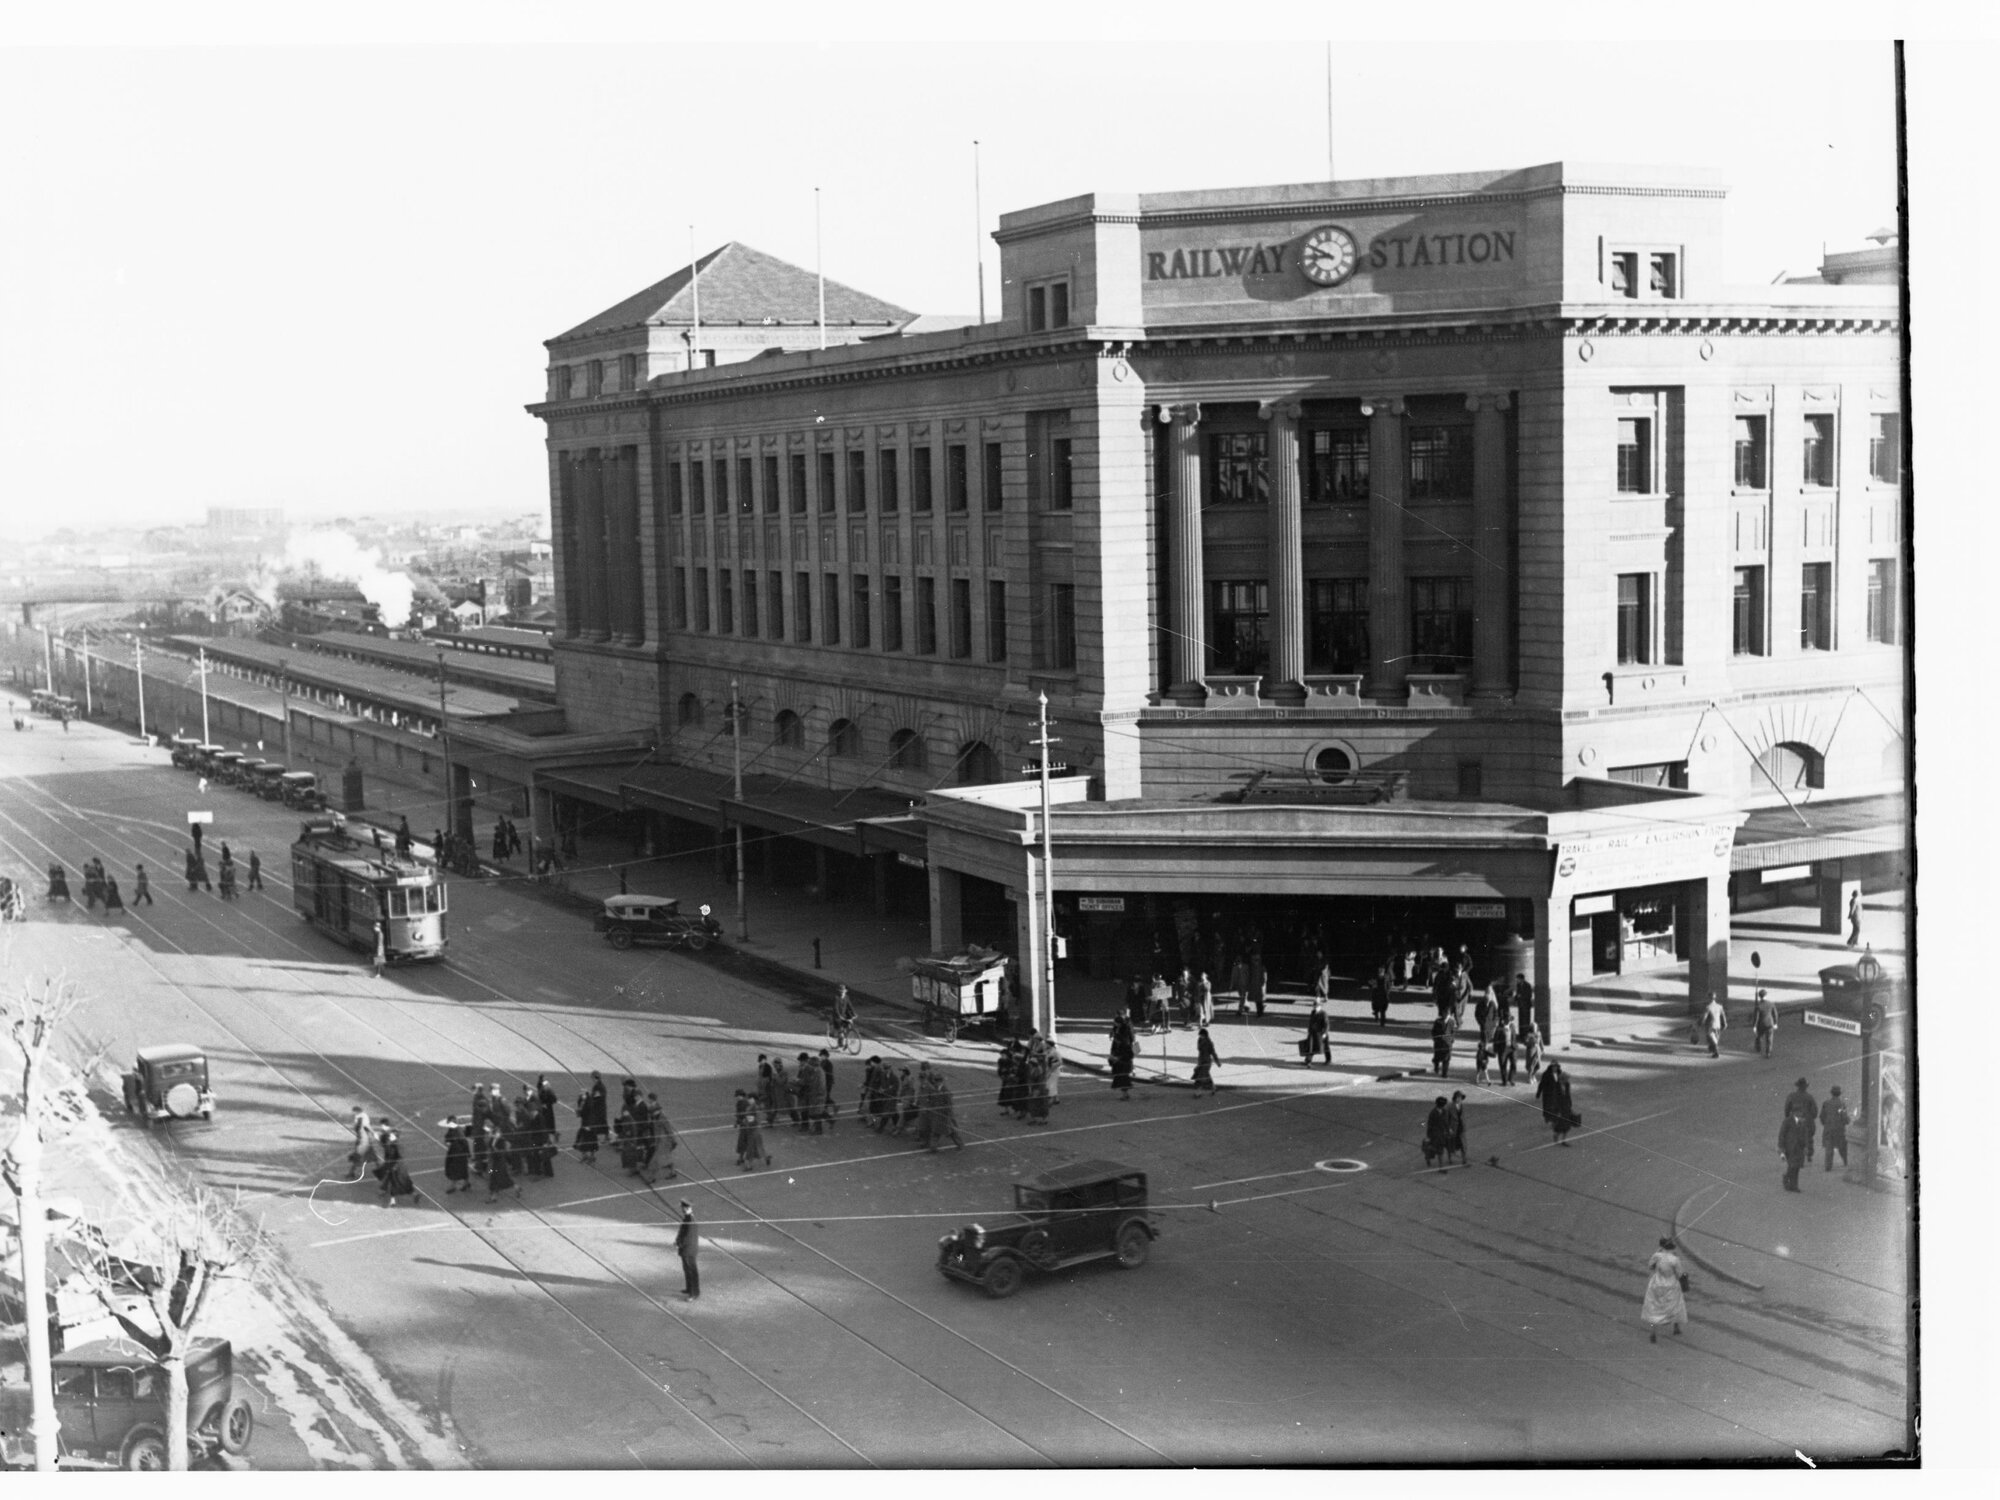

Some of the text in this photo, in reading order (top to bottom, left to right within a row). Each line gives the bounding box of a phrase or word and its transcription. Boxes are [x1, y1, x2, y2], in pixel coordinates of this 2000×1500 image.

[1147, 231, 1516, 281] RAILWAY STATION
[1562, 843, 1592, 855] TRAVEL
[1807, 1013, 1816, 1023] NO
